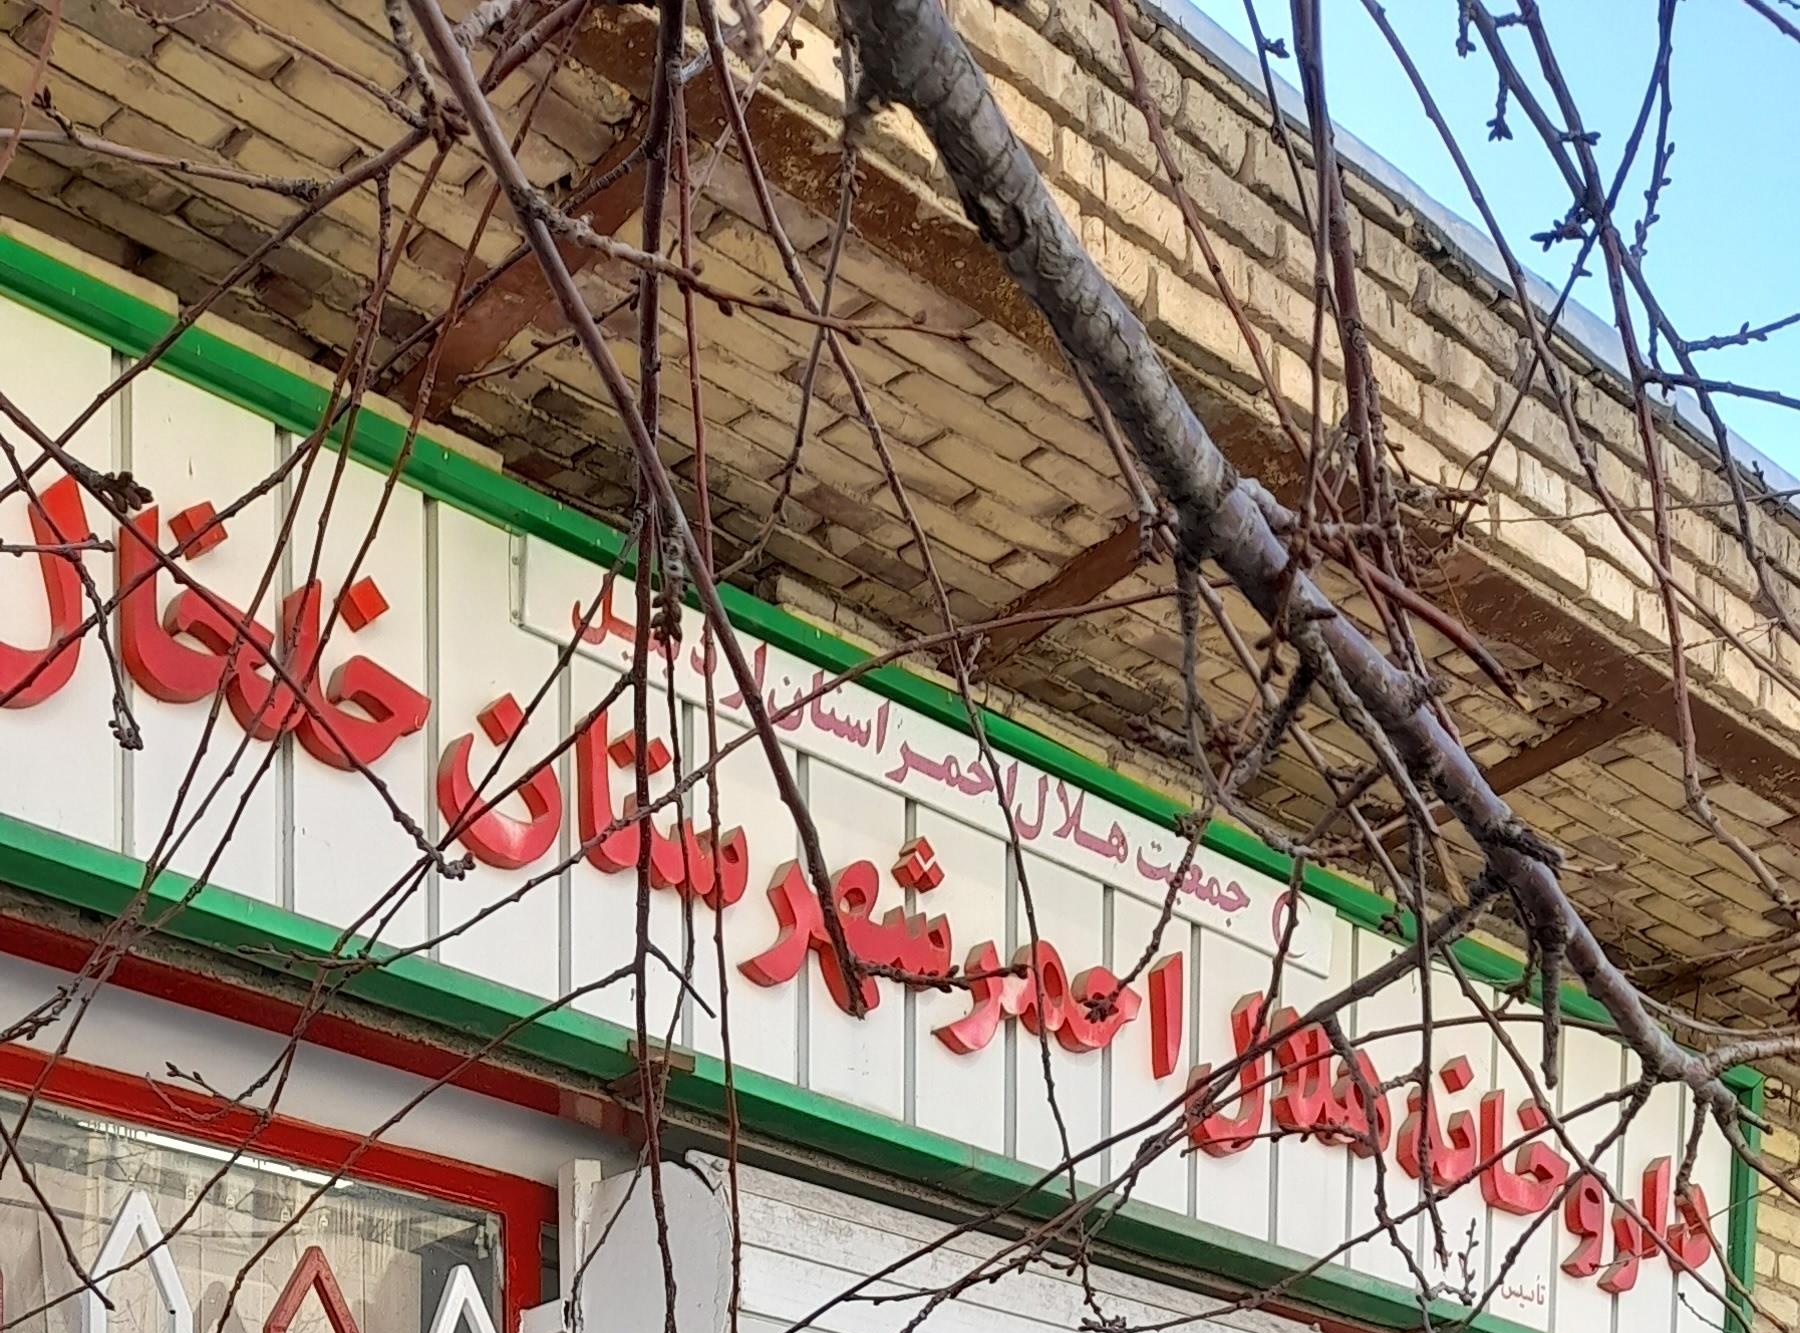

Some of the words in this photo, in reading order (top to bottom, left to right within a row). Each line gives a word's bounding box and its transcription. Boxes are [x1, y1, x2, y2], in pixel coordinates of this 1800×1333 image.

[0, 474, 431, 772] خلخال
[771, 666, 889, 757] استان
[885, 738, 1018, 812] احمر
[437, 692, 953, 1017] شهرستان
[1015, 773, 1128, 863] هلال
[1136, 834, 1250, 926] جمعیت
[932, 939, 1183, 1080] احمر
[1185, 989, 1391, 1159] هلال
[1396, 1054, 1712, 1295] داروخانه
